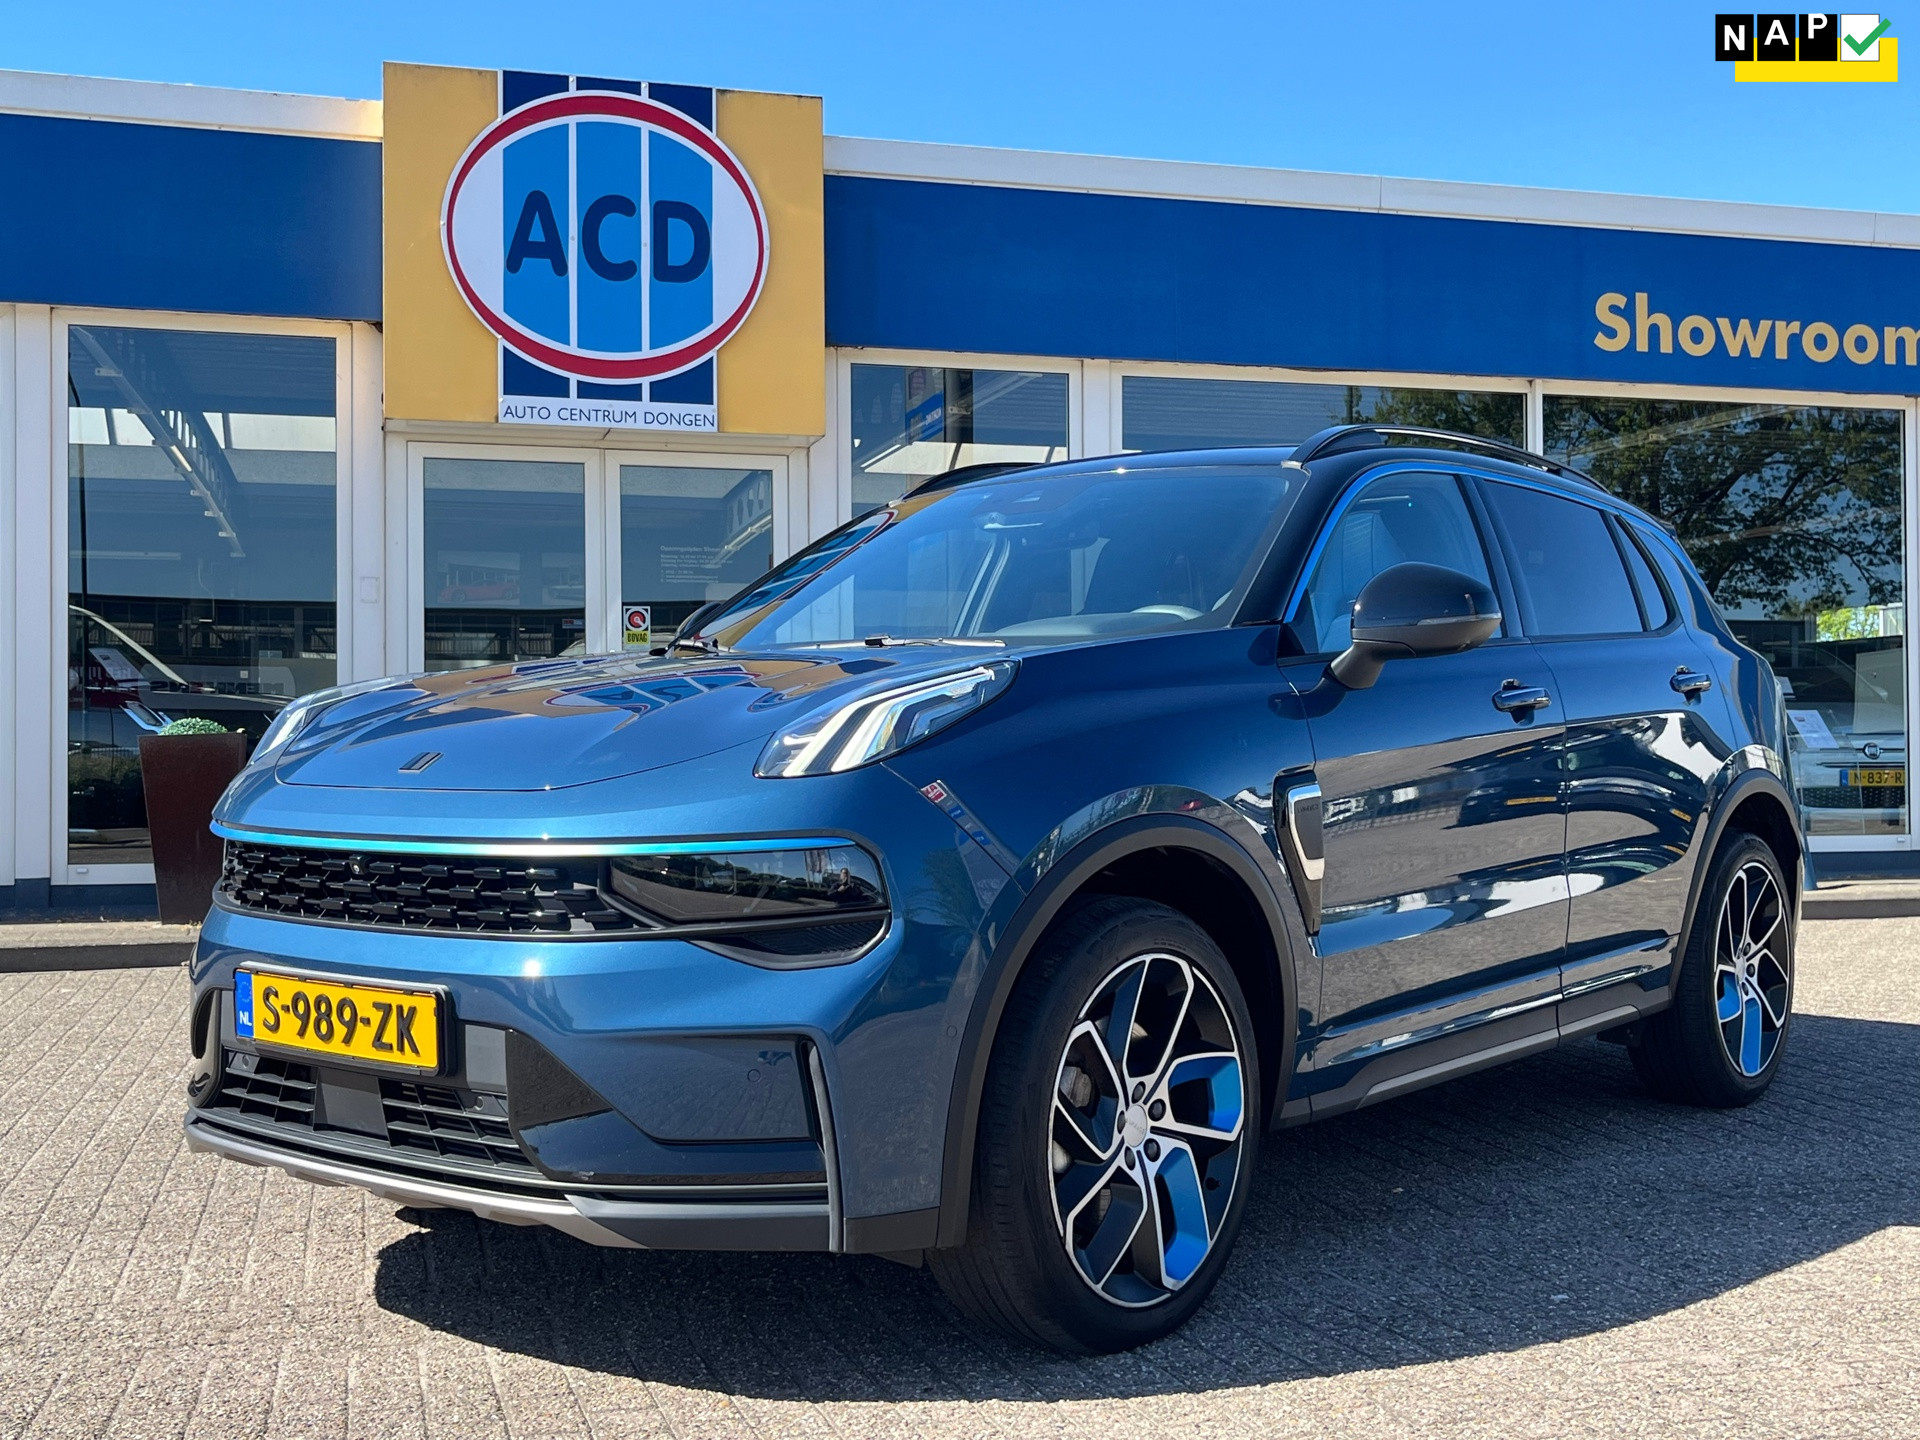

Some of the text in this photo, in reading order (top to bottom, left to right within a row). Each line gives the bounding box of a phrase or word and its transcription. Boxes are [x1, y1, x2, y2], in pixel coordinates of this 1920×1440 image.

[505, 189, 711, 284] ACD
[1593, 292, 1920, 366] Showroom
[503, 405, 716, 428] AUTO CENTRUM DONGEN
[239, 1010, 253, 1027] NL
[262, 986, 421, 1058] S-989-ZK
